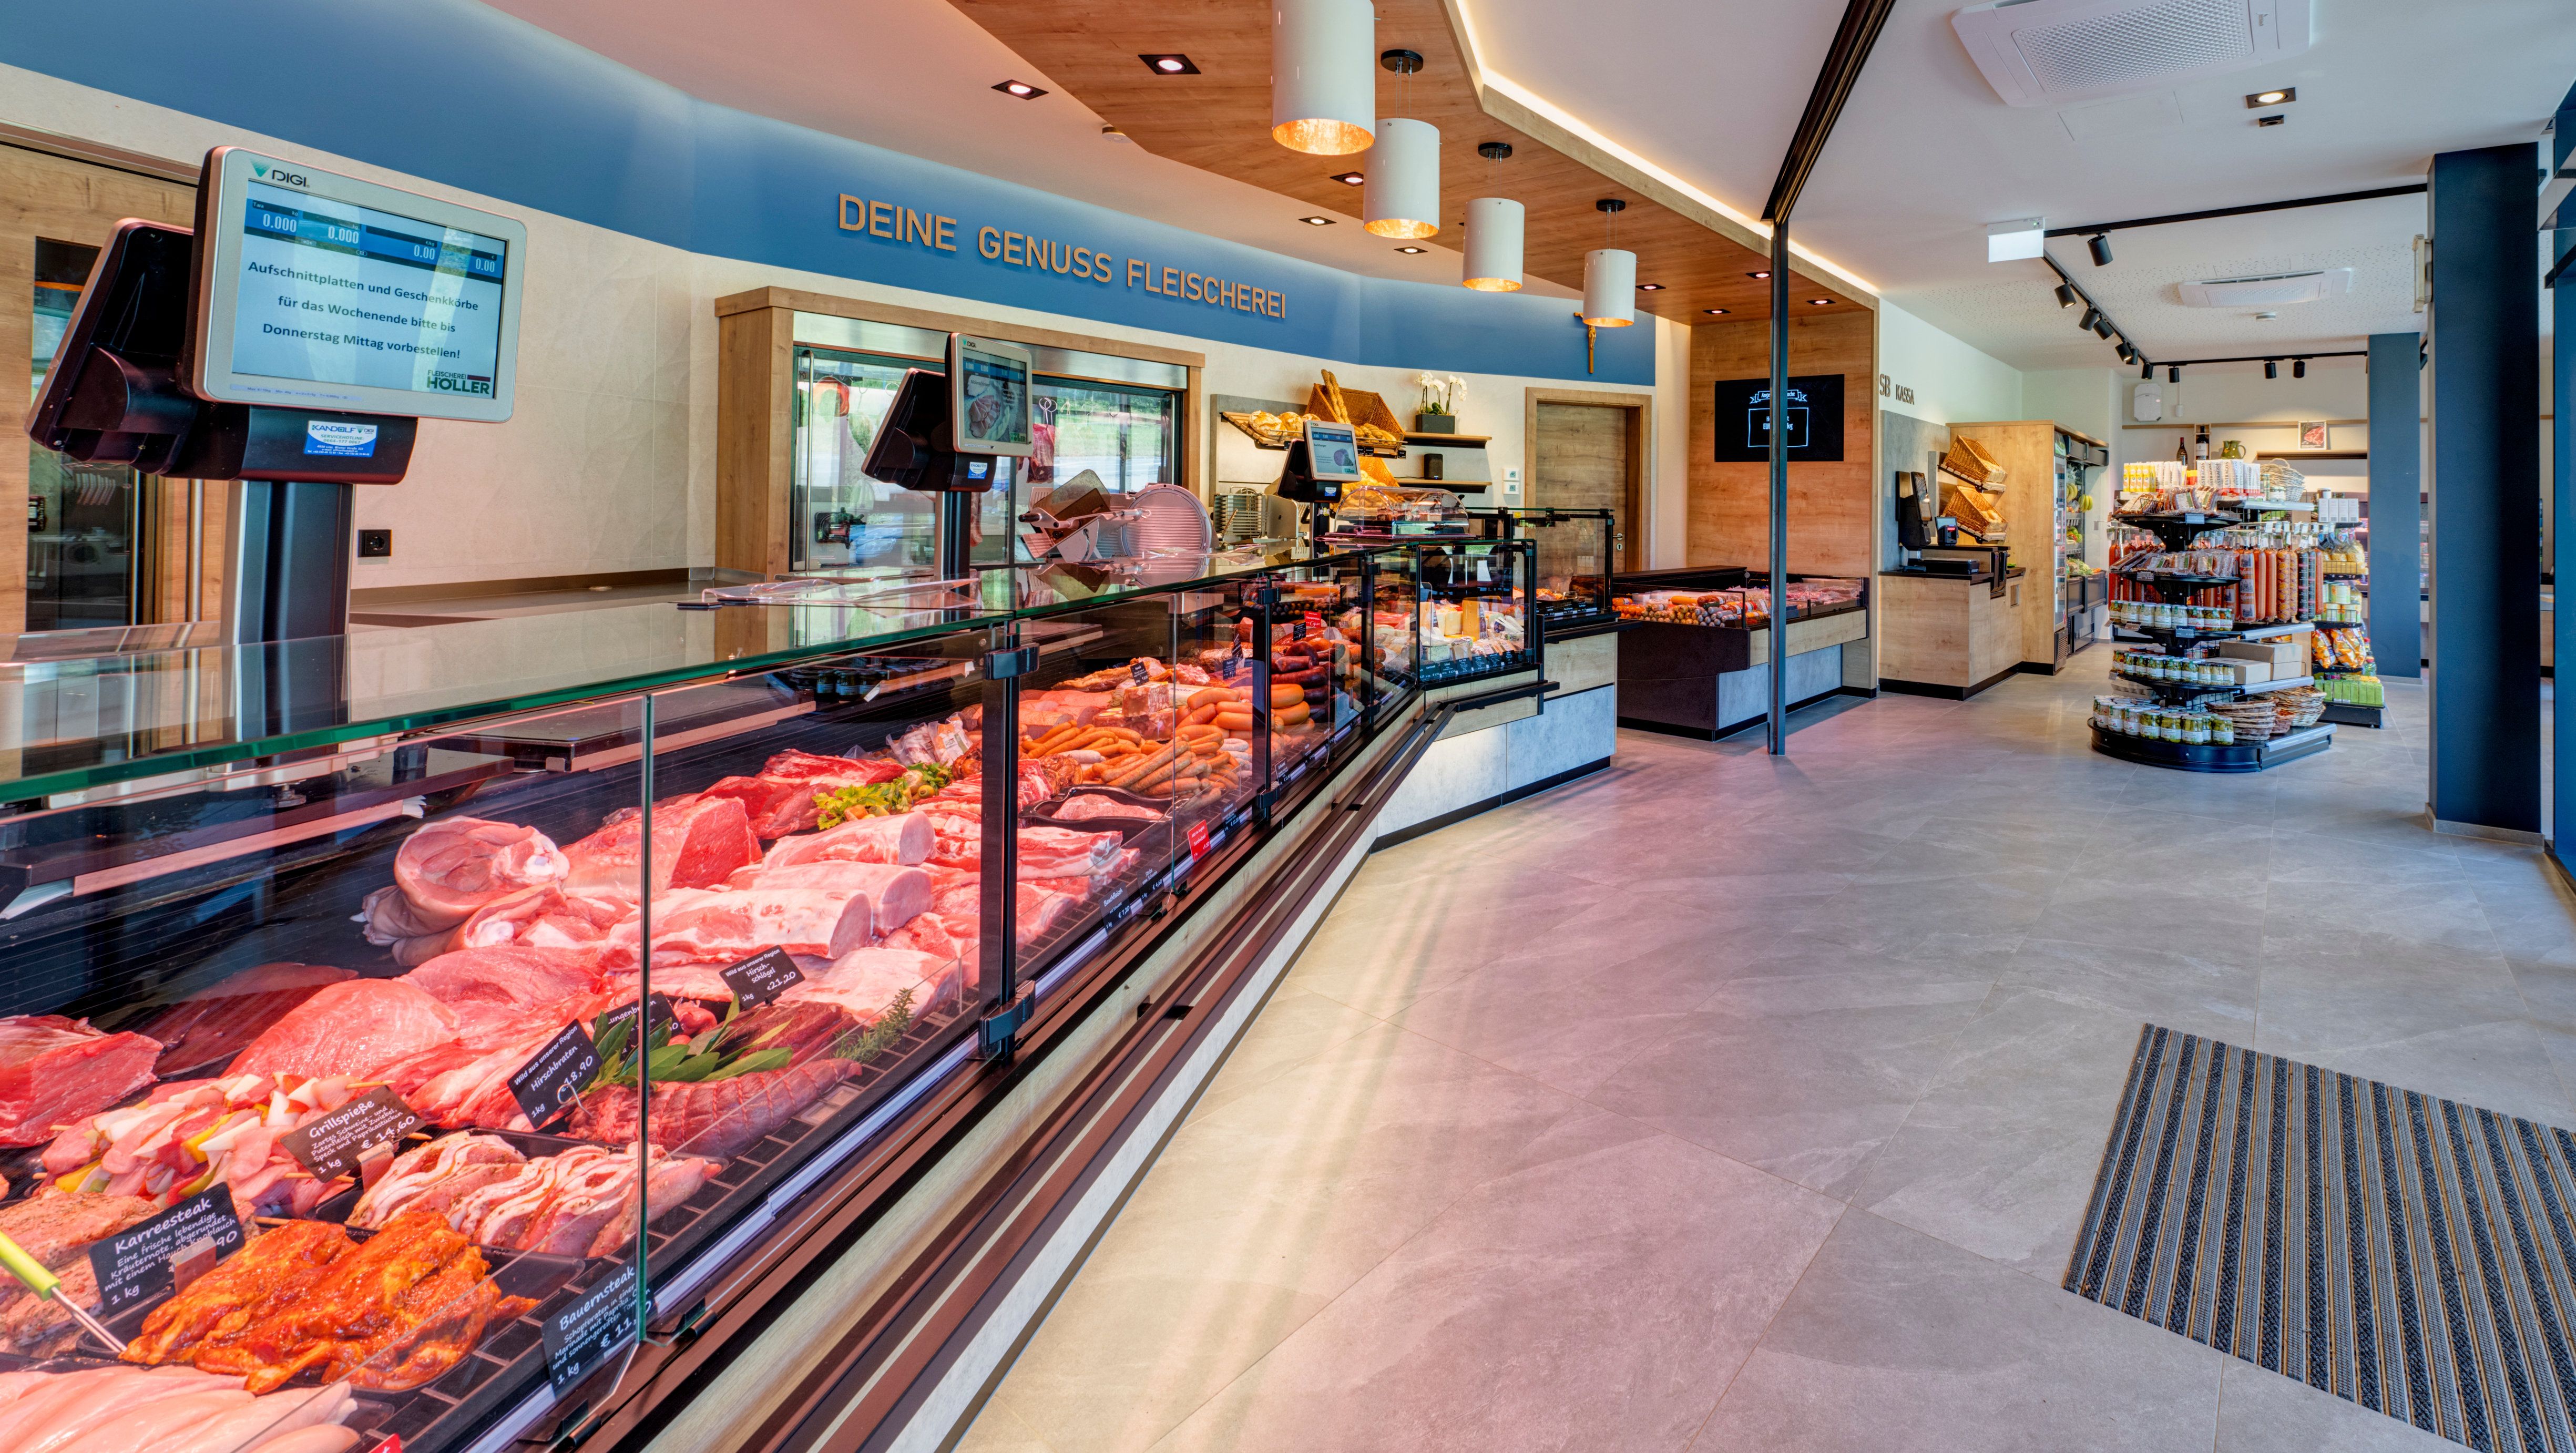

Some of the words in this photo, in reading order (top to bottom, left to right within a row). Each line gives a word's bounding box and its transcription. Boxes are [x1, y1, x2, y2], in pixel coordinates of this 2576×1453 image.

[272, 169, 307, 187] DIGI
[263, 213, 297, 232] 0.000
[328, 226, 359, 244] 0.000
[414, 245, 435, 260] 0.00
[475, 258, 495, 272] 0.00
[839, 193, 957, 252] DEINE
[978, 226, 1112, 283] GENUSS
[1127, 259, 1286, 319] FLEISCHEREI
[248, 262, 364, 290] Aufschnittplatten
[368, 286, 391, 295] und
[394, 288, 479, 310] Geschenkkörbe
[278, 295, 298, 308] für
[302, 300, 324, 312] das
[328, 304, 407, 325] Wochenende
[411, 317, 437, 329] bitte
[441, 322, 455, 332] bis
[263, 323, 340, 345] Donnerstag
[343, 334, 383, 350] Mittag
[387, 342, 460, 359] vorbestellen!
[427, 370, 466, 380] FLEISCHEREI
[427, 376, 489, 394] HÖLLER
[1879, 374, 1890, 397] SB
[1896, 384, 1915, 405] KASSA
[1103, 887, 1123, 907] Bauchfleisch
[746, 963, 770, 977] Hirsch-
[747, 957, 764, 968] unserer
[764, 949, 780, 959] Region
[751, 967, 775, 983] schlögel
[514, 1071, 528, 1086] Wild
[528, 1062, 539, 1073] aus
[539, 1042, 560, 1063] unserer
[559, 1026, 577, 1045] Region
[530, 1046, 578, 1091] Hirschbraten
[309, 1100, 374, 1138] Grillspieße
[312, 1133, 336, 1149] Zartes
[336, 1115, 373, 1136] Schweine-
[374, 1106, 388, 1117] und
[361, 1140, 373, 1150] €
[375, 1115, 415, 1142] 14,60
[311, 1132, 354, 1155] Putenfleisch
[355, 1123, 368, 1133] mit
[314, 1147, 336, 1162] Speck
[337, 1140, 351, 1149] und
[352, 1111, 403, 1141] Paprikastücken
[327, 1159, 342, 1170] kg
[115, 1198, 211, 1254] Karreesteak
[117, 1252, 138, 1268] Eine
[141, 1234, 172, 1255] frische
[175, 1212, 217, 1237] lebendige
[175, 1214, 227, 1246] abgerundet
[105, 1278, 124, 1292] mit
[125, 1262, 156, 1280] einem
[158, 1244, 187, 1263] Hauch
[111, 1294, 121, 1305] 1
[124, 1285, 139, 1298] kg
[559, 1266, 635, 1331] Bauernsteak
[565, 1305, 610, 1344] Schopfbraten
[619, 1283, 636, 1299] einer
[553, 1355, 567, 1370] und
[569, 1312, 621, 1357] sonnengereiften
[555, 1329, 588, 1359] Marinade
[590, 1317, 602, 1331] mit
[600, 1334, 611, 1348] €
[557, 1374, 565, 1385] 1
[567, 1362, 580, 1377] kg
